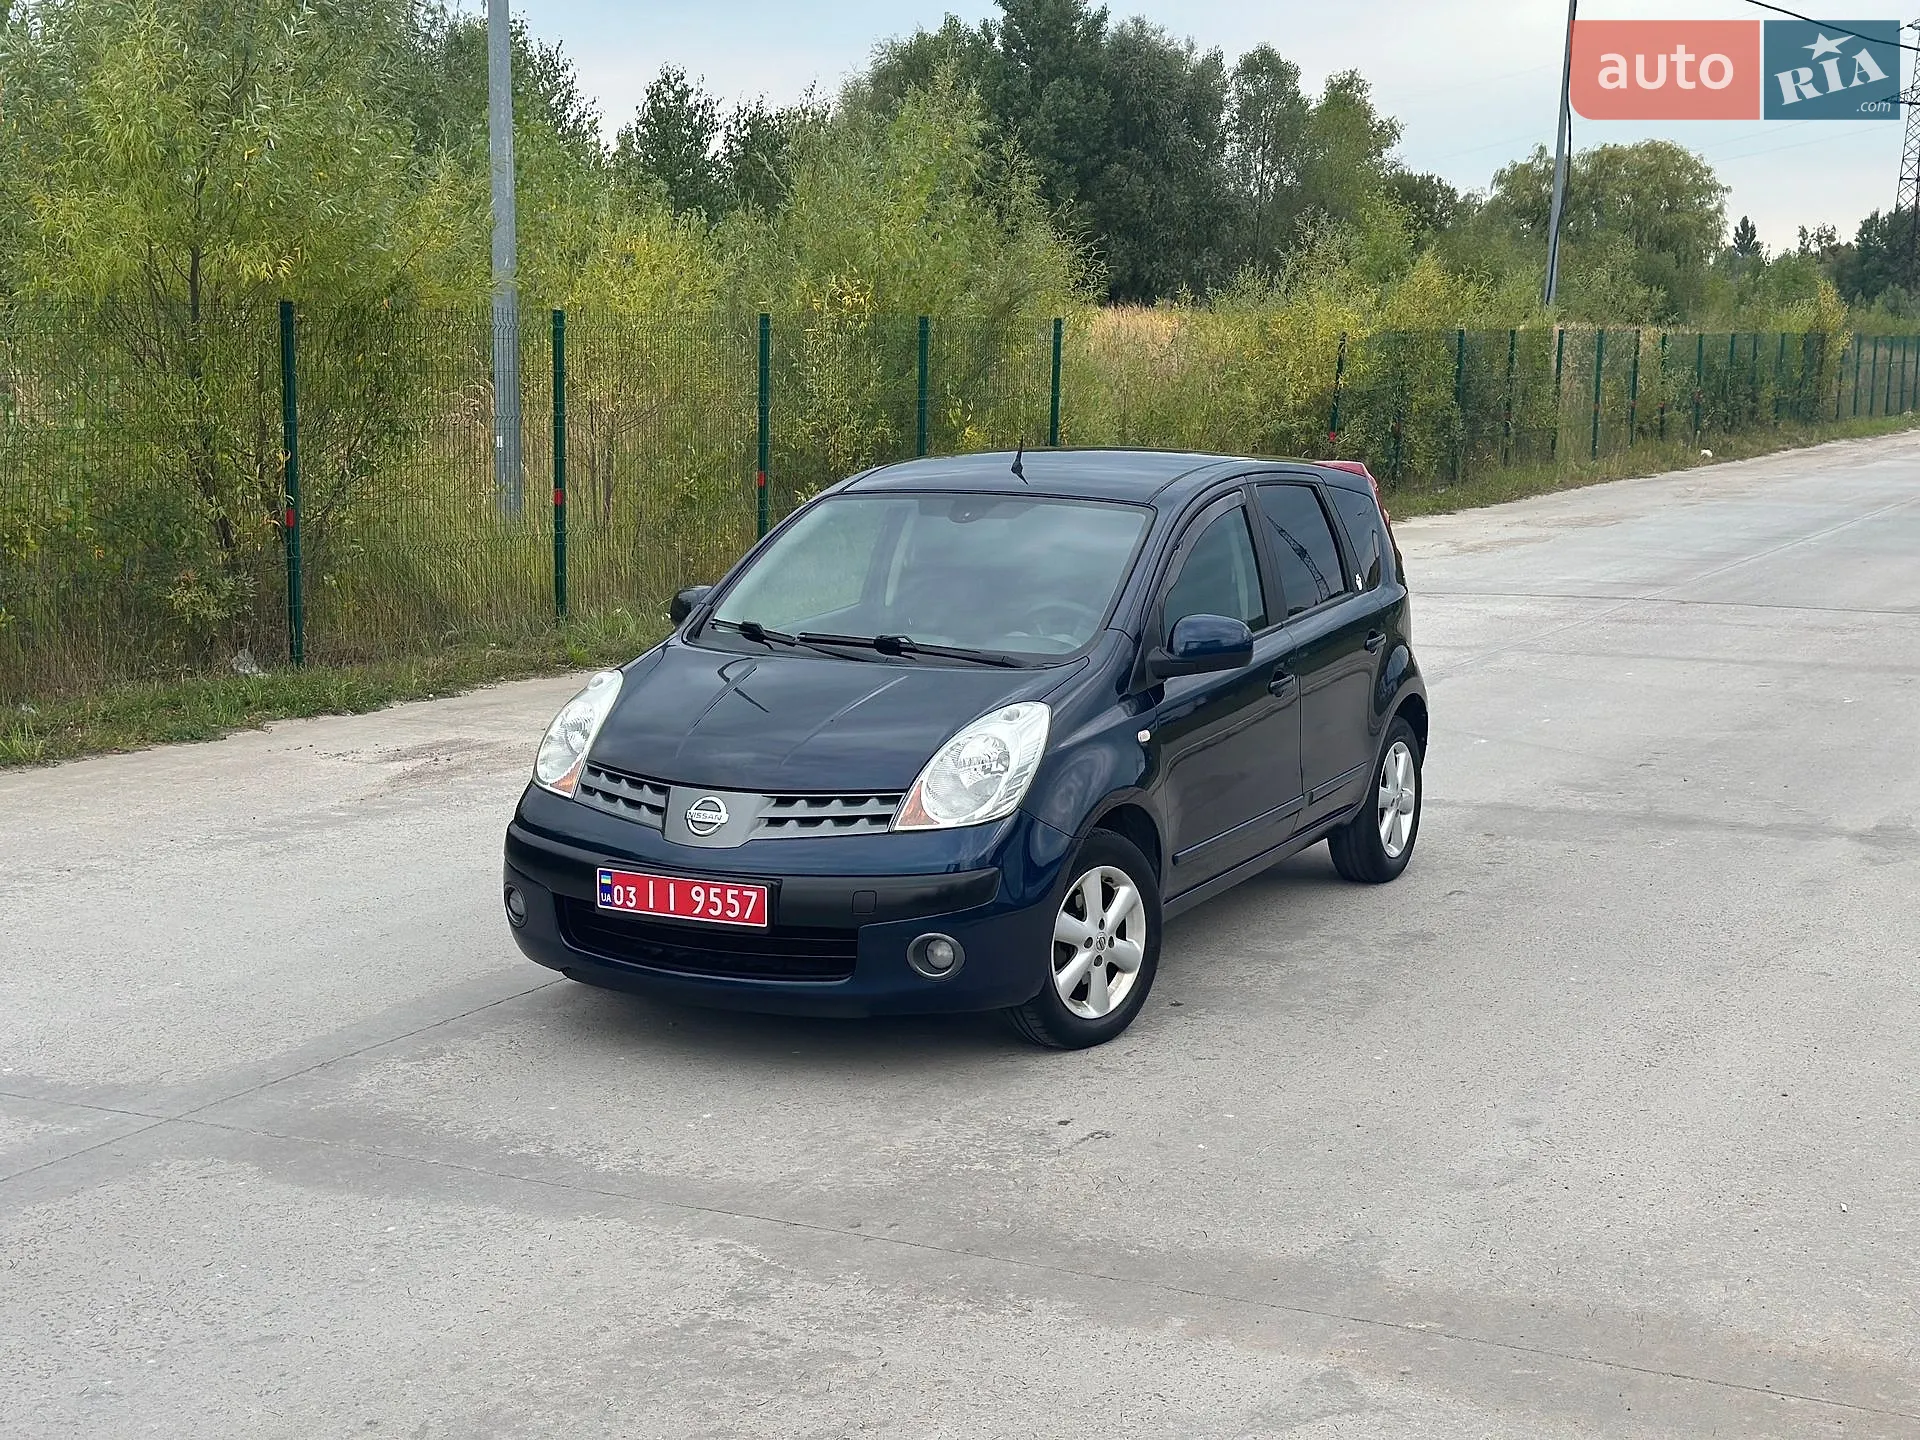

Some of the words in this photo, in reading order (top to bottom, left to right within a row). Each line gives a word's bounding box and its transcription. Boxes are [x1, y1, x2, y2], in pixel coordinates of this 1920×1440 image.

[687, 811, 723, 821] NISSAN
[601, 892, 612, 903] UA
[613, 885, 637, 908] 03
[690, 885, 758, 920] 9557
